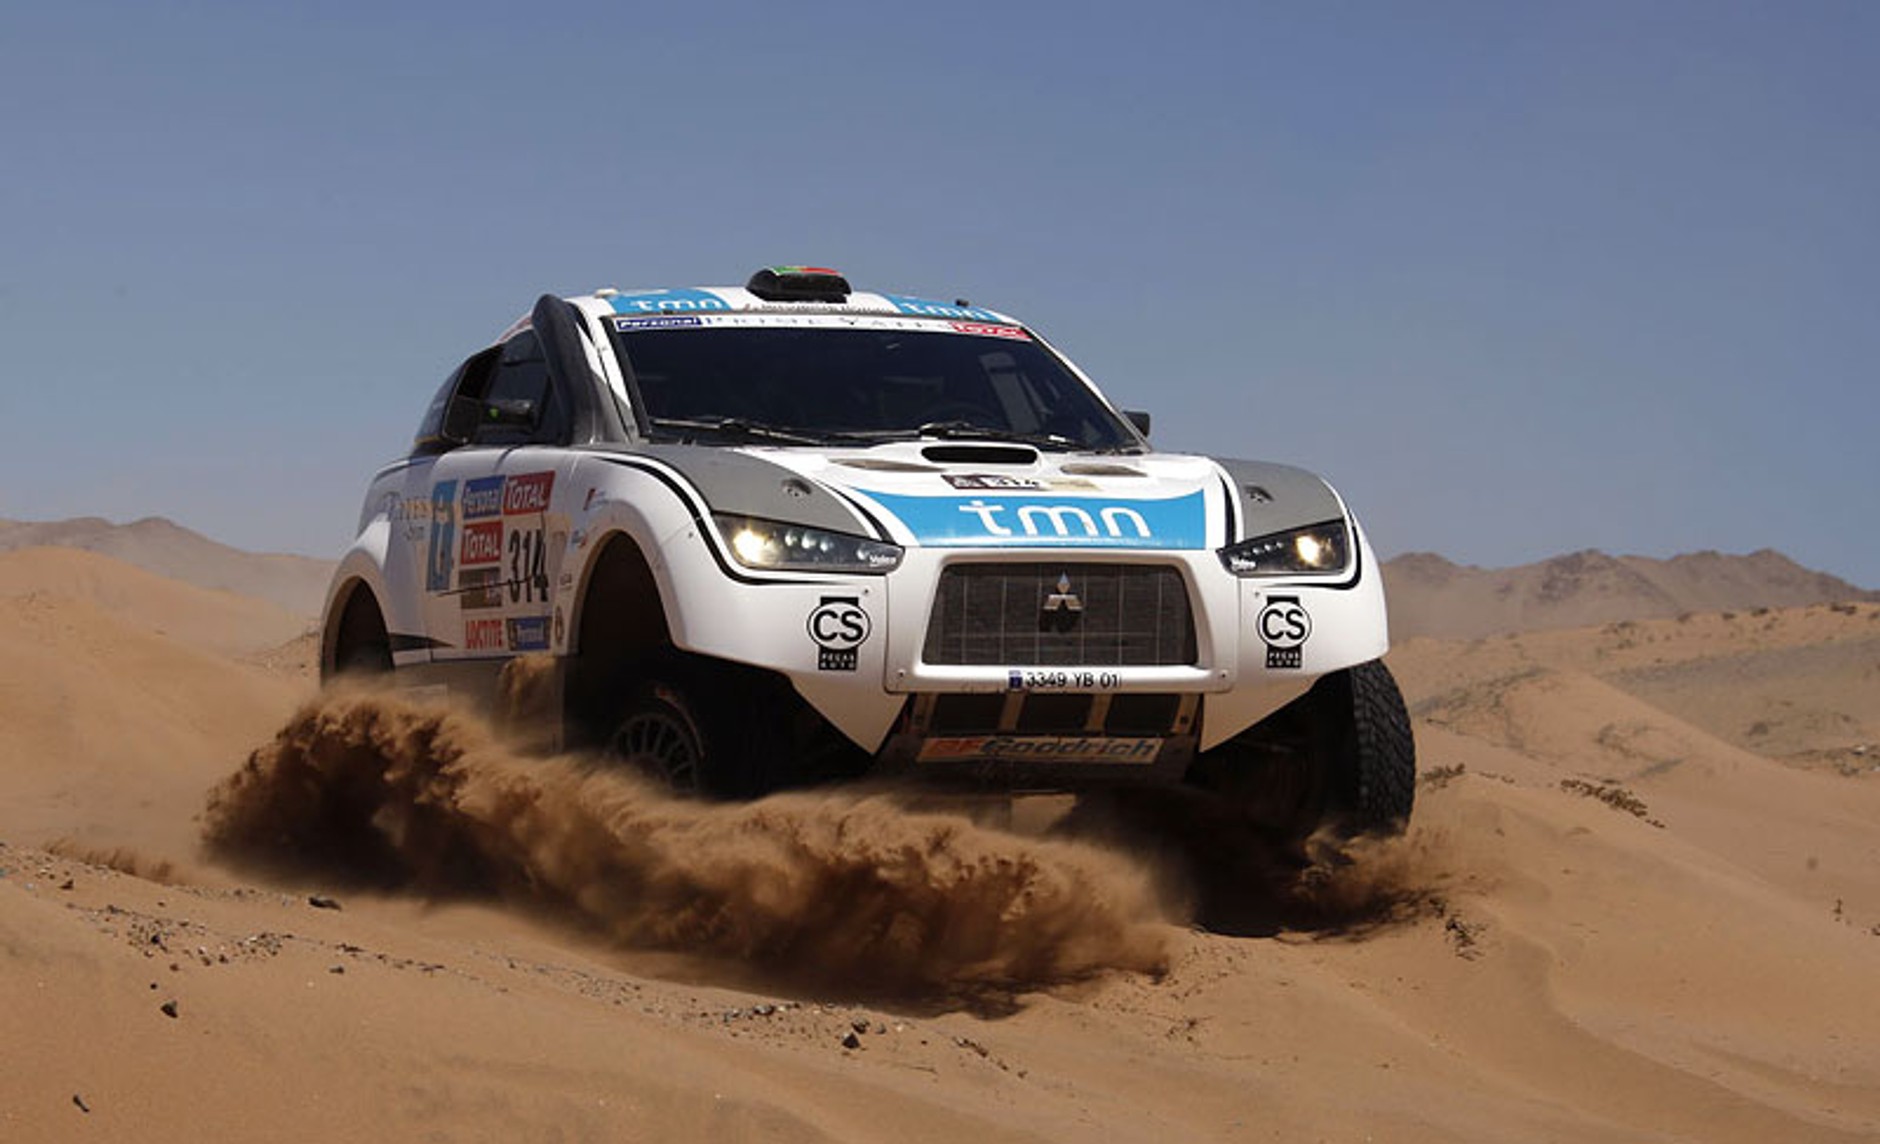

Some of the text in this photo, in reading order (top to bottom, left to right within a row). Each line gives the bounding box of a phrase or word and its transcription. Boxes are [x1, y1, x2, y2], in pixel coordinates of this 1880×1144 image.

[630, 298, 723, 311] tmn
[506, 480, 547, 510] TOTAL
[959, 500, 1151, 538] tmn
[462, 527, 500, 559] TOTAL
[508, 528, 549, 603] 314
[813, 609, 865, 642] CS
[1261, 609, 1306, 641] CS
[1025, 671, 1119, 689] 3349 YB 01
